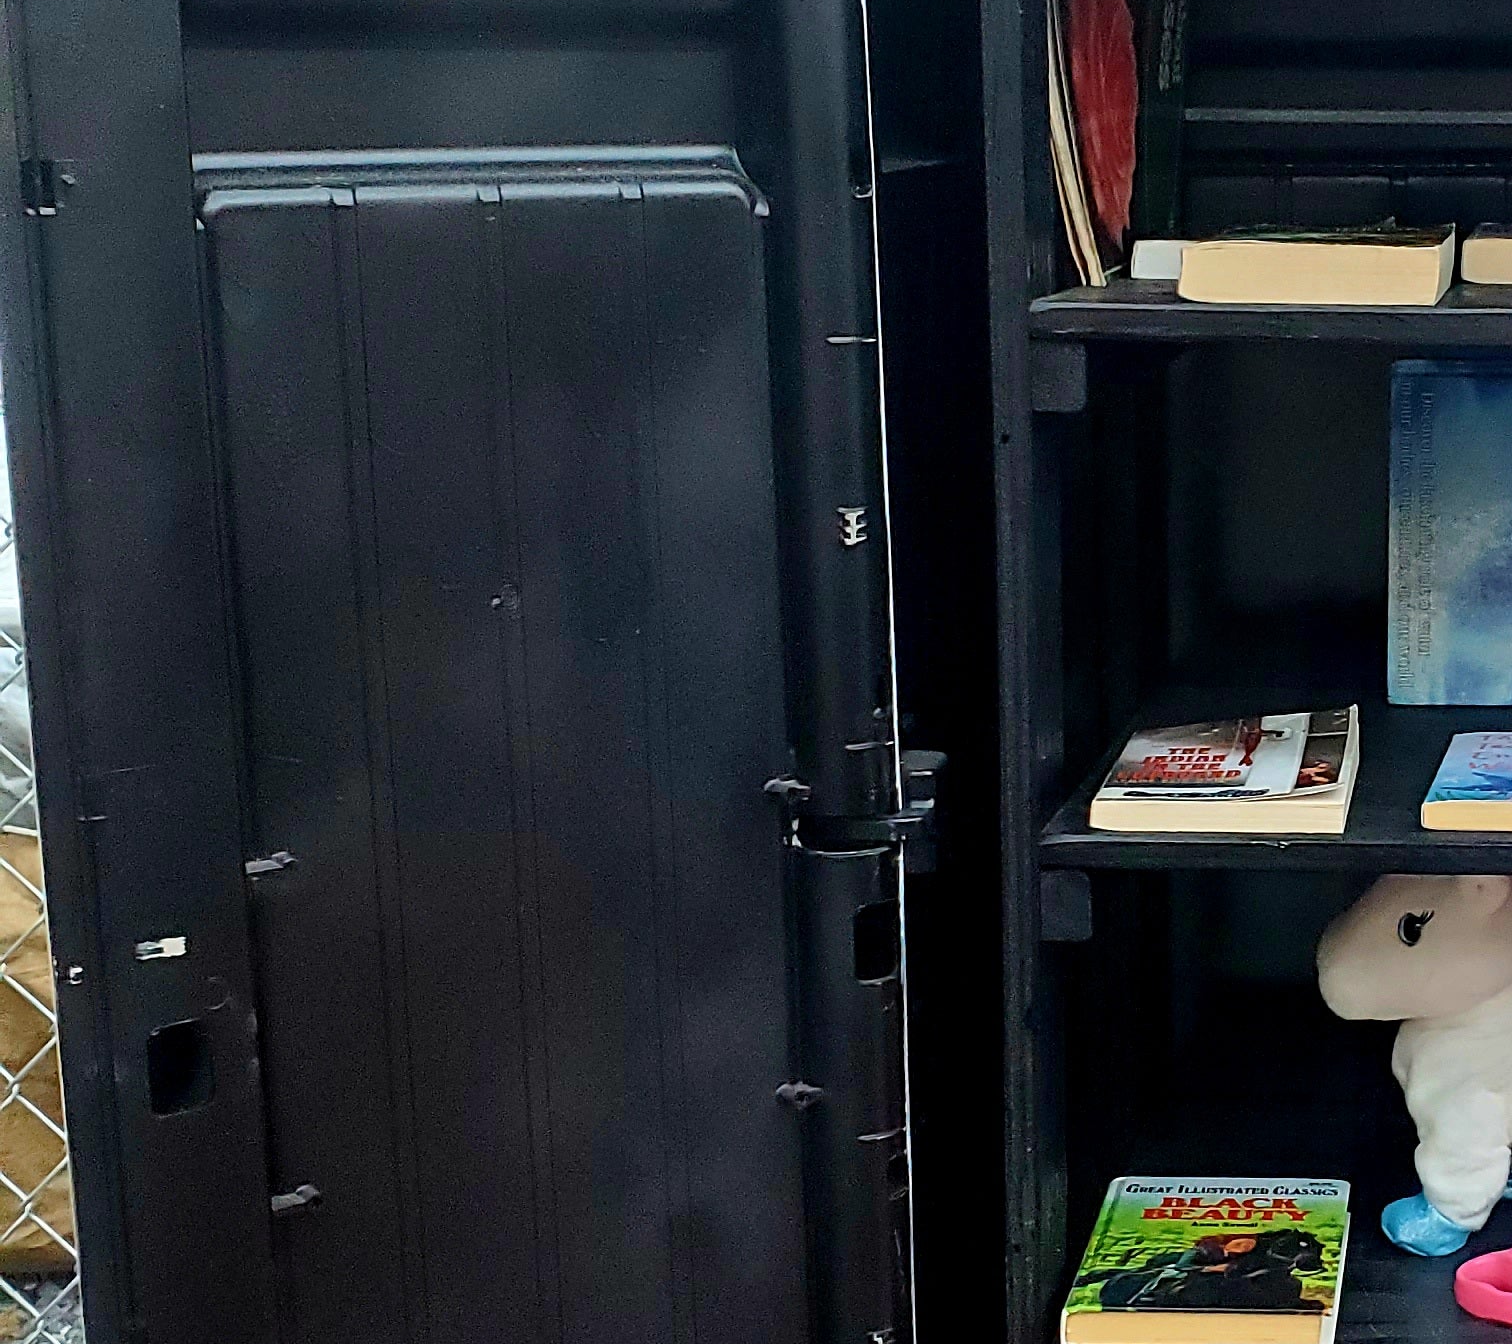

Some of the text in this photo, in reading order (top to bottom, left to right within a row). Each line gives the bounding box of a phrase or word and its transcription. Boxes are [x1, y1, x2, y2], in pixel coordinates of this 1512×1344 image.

[1168, 747, 1211, 755] THE
[1125, 1183, 1339, 1196] GREAT ILLUSTRATED CLASSICS
[1159, 1197, 1301, 1209] BLACK
[1141, 1208, 1313, 1222] BEAUTY
